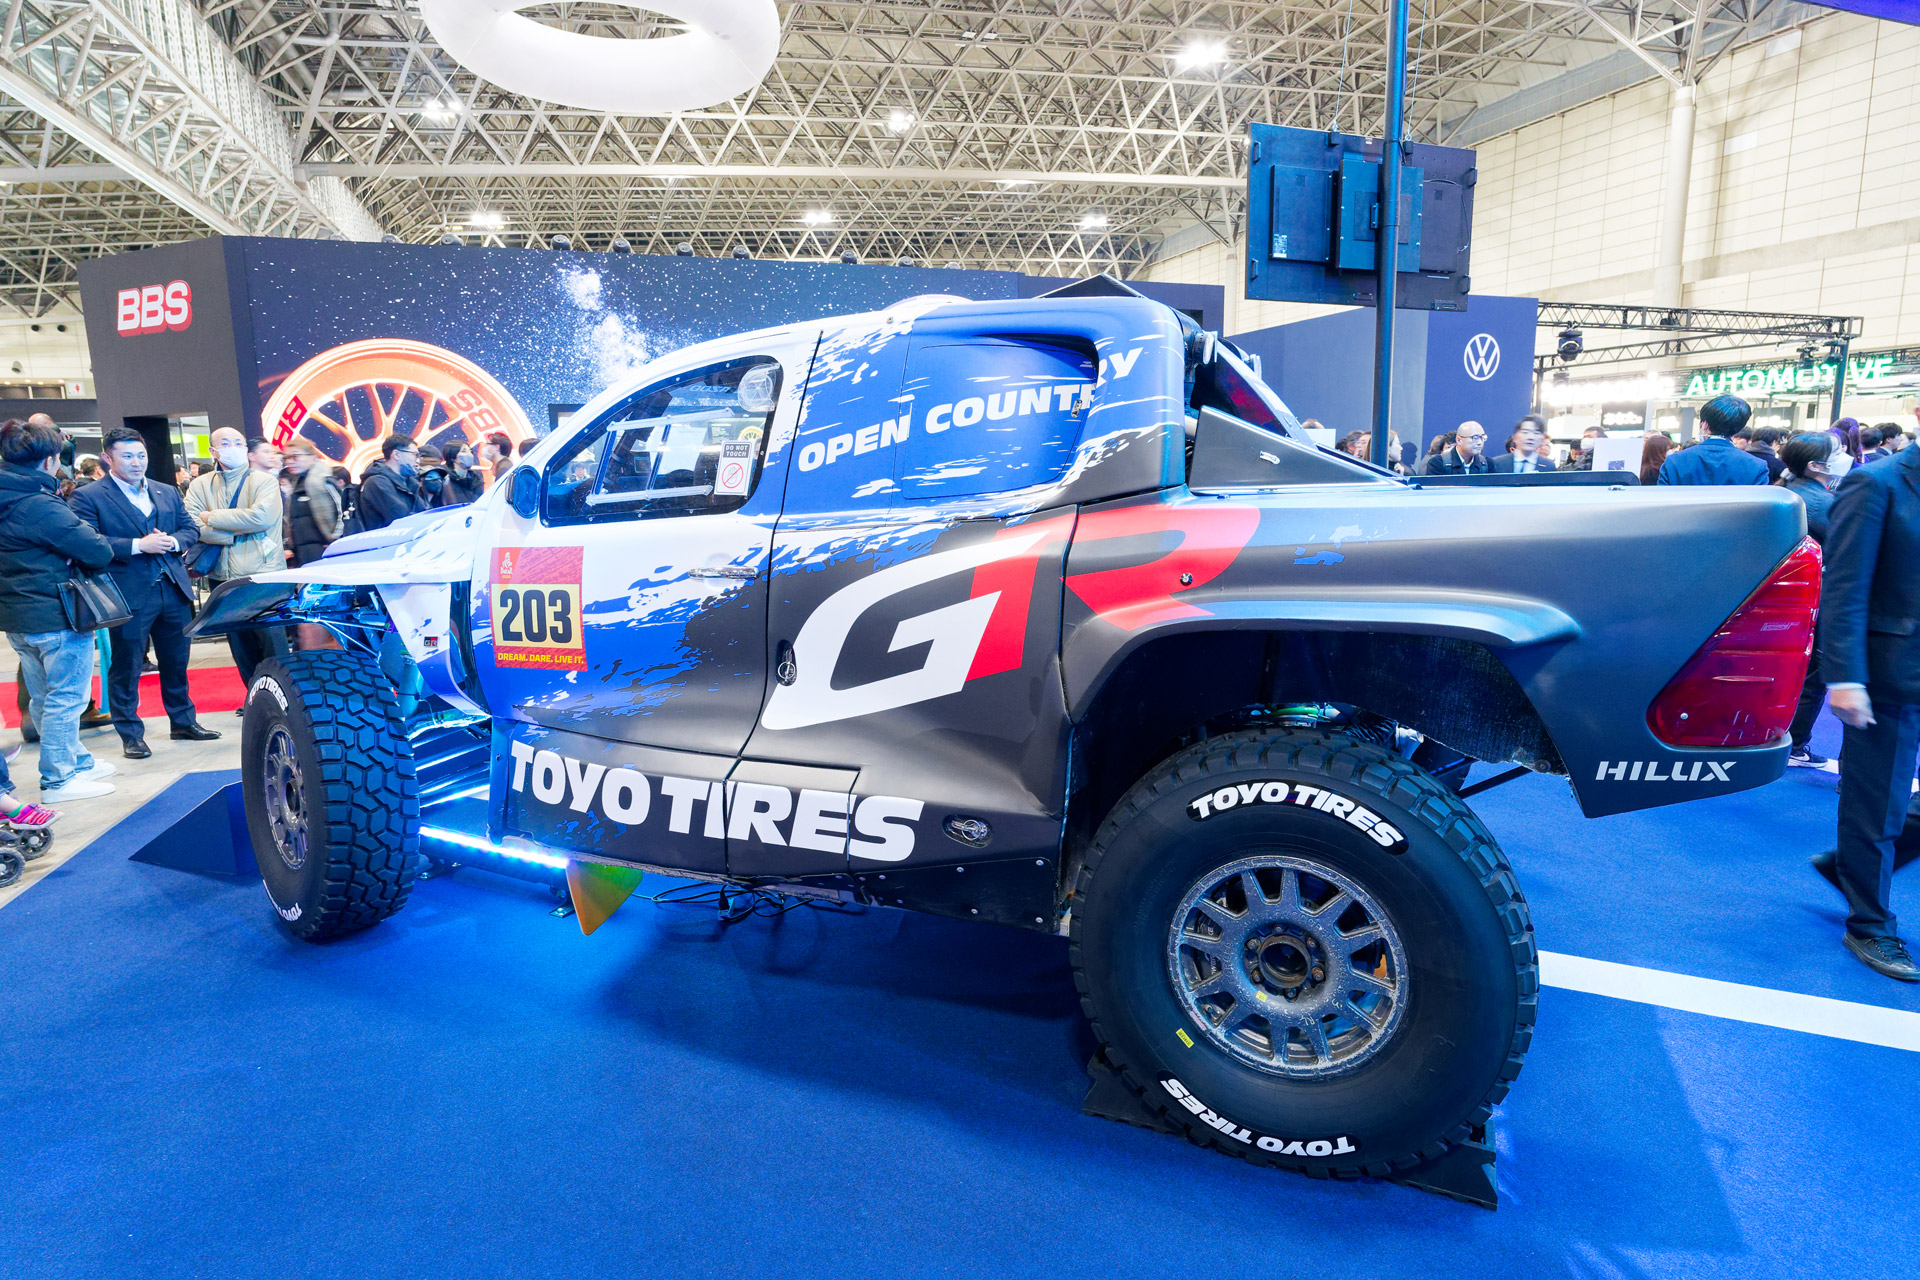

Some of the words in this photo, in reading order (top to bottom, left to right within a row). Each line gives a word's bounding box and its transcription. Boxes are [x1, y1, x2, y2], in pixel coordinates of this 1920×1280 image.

[117, 280, 193, 337] BBS
[1686, 357, 1894, 397] AUTOMOTVE
[798, 403, 913, 472] OPEN
[925, 347, 1144, 434] COUNTRY
[500, 589, 572, 643] 203
[497, 652, 528, 661] DREAM.
[529, 654, 553, 663] DARE.
[555, 655, 572, 663] LIVE
[574, 656, 584, 664] IT.
[1595, 761, 1737, 782] HILUX
[510, 739, 651, 826] TOYO
[660, 776, 925, 862] TIRES
[1192, 782, 1290, 819] TOYO
[1293, 784, 1404, 847] TIRES
[1160, 1078, 1253, 1145] TIRES
[1256, 1136, 1356, 1157] TOYO
